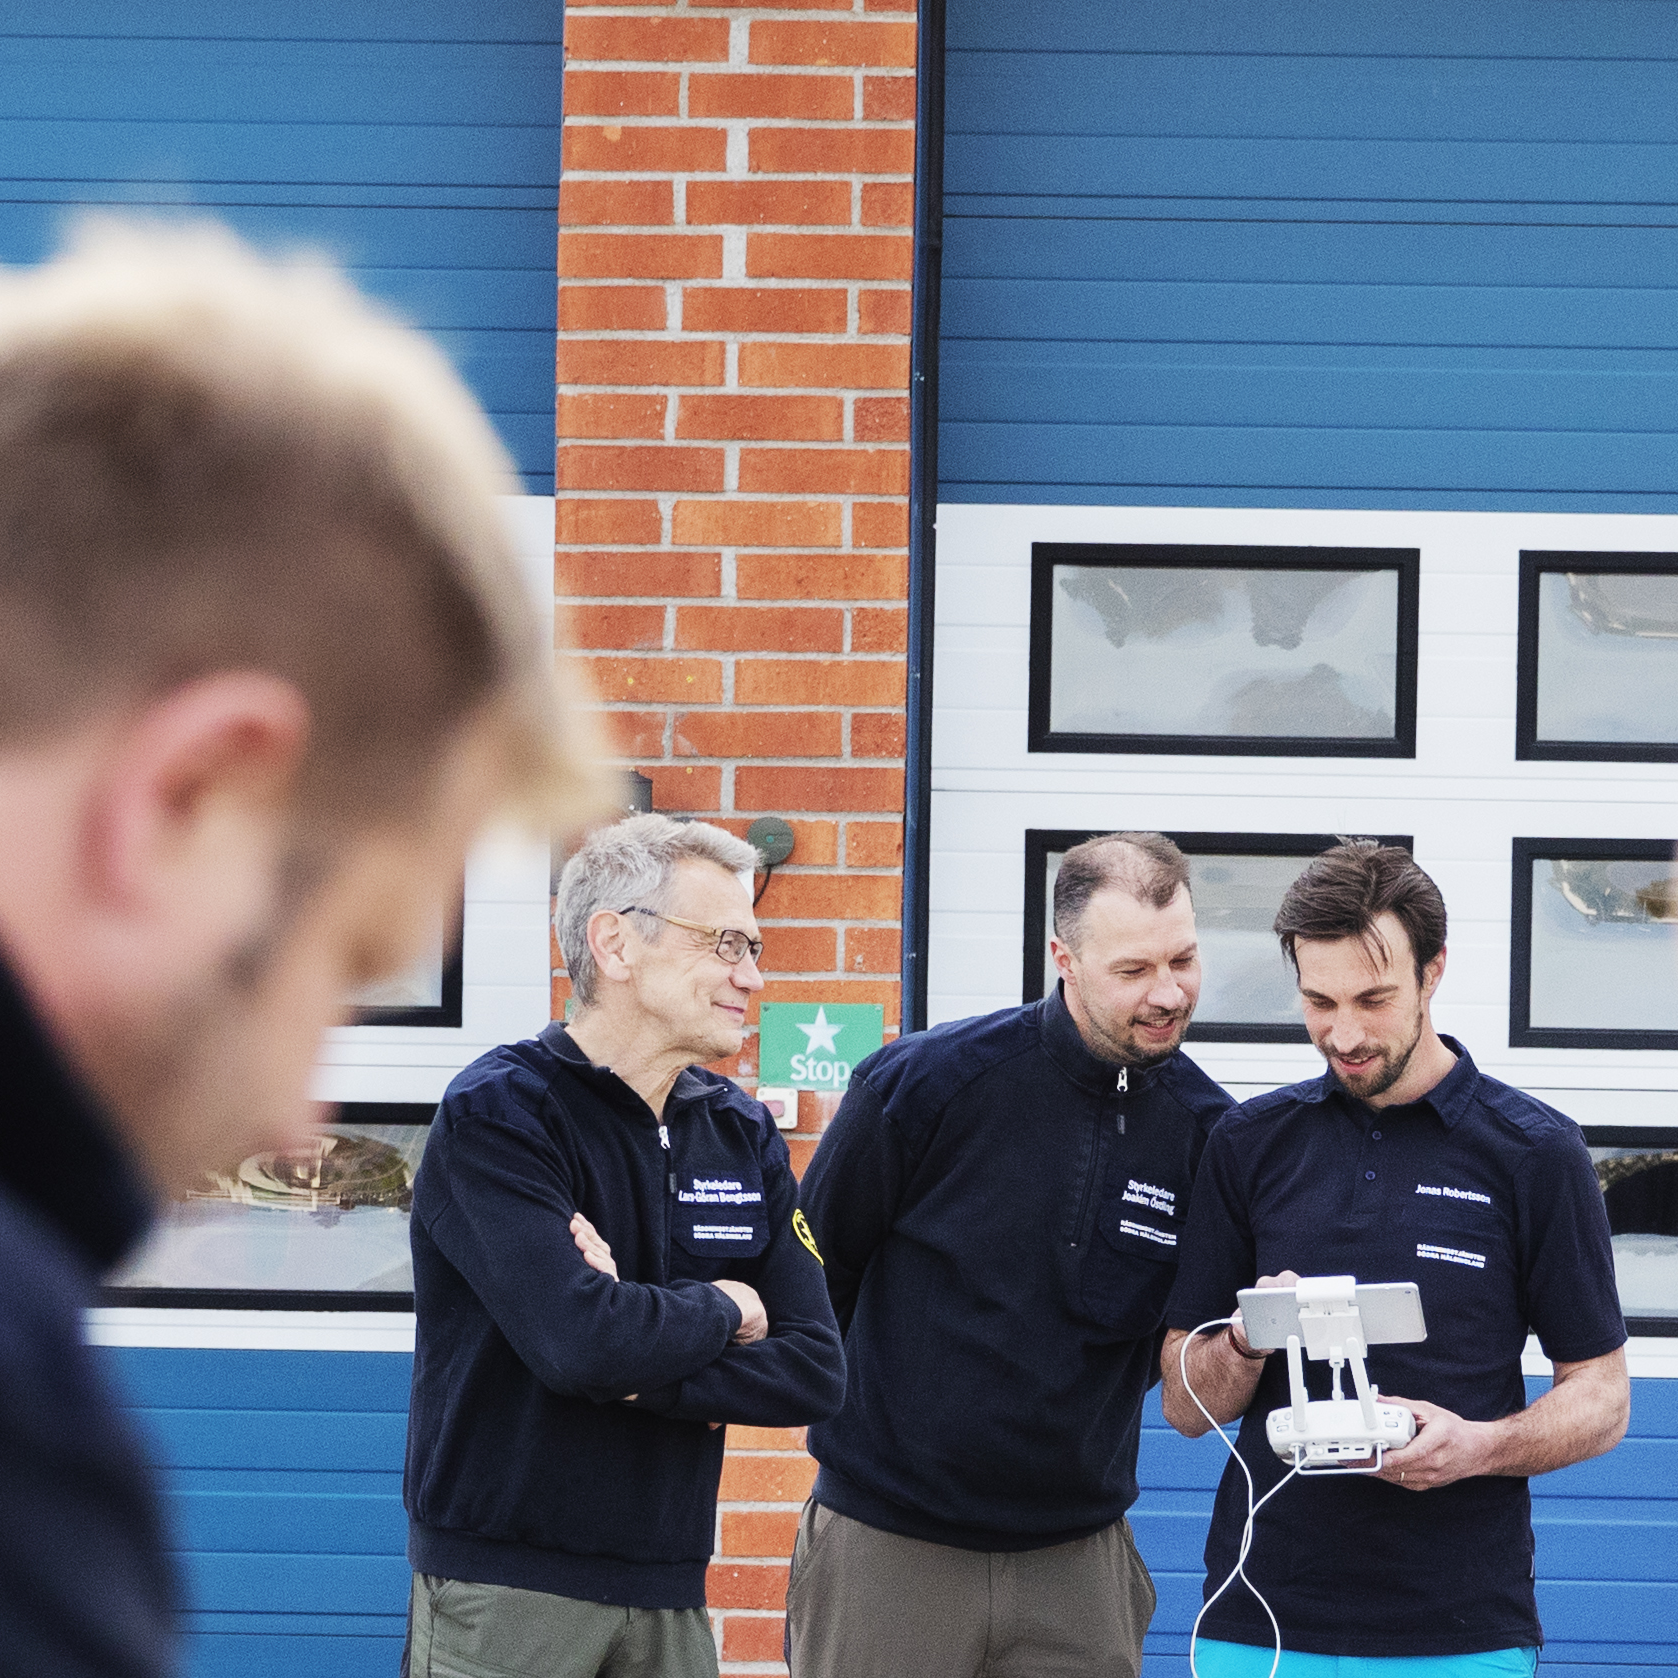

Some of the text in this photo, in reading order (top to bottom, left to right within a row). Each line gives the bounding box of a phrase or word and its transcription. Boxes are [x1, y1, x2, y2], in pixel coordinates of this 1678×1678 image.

[790, 1053, 851, 1088] Stop
[1415, 1184, 1491, 1205] Jonas Robertsson
